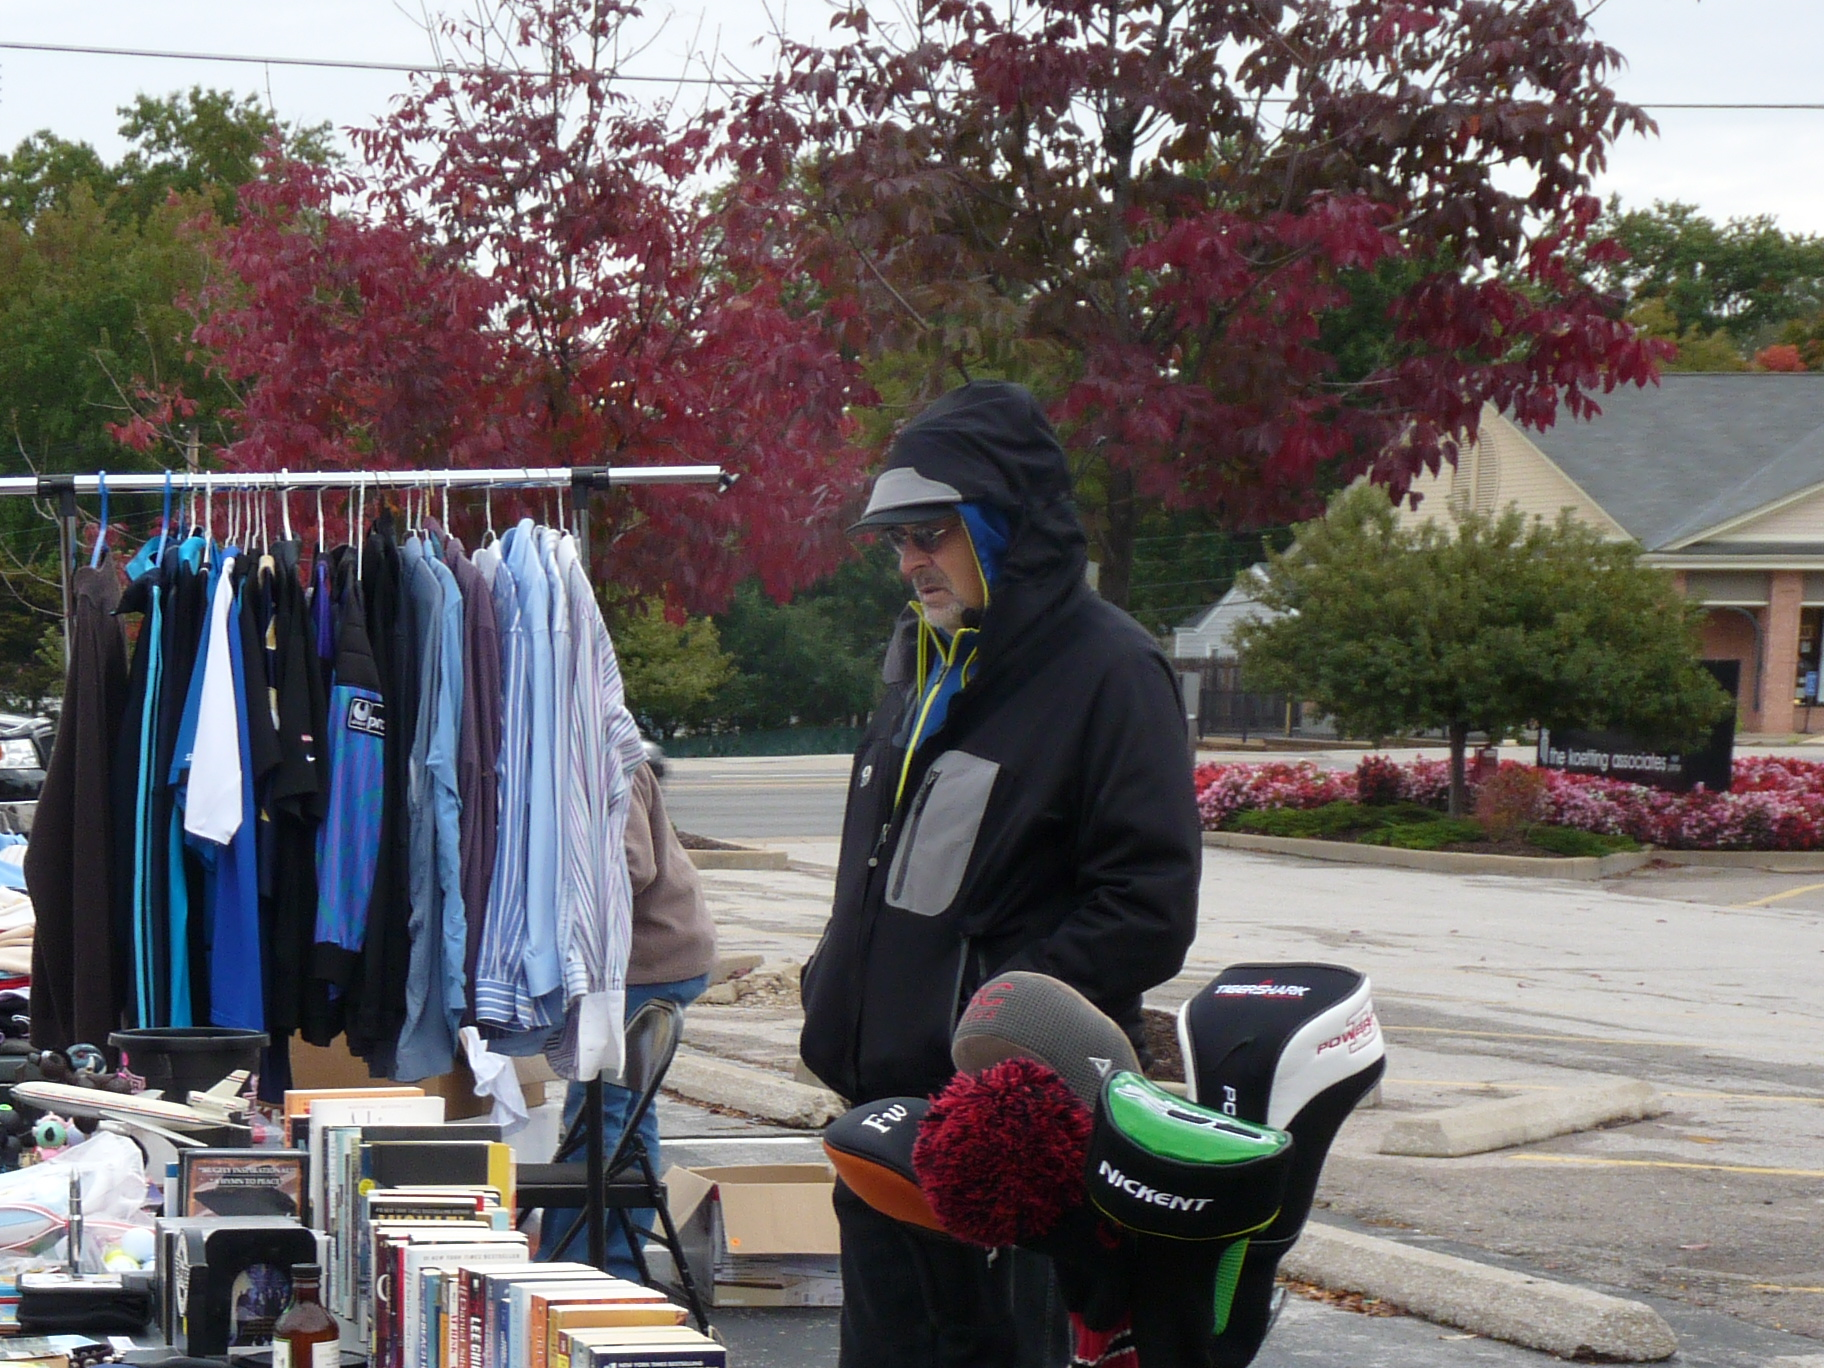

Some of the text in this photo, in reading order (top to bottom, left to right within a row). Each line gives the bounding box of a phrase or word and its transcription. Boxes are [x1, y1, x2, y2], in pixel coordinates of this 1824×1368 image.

[1612, 752, 1668, 772] associates
[1214, 984, 1311, 996] TIGERSHARK
[1098, 1160, 1214, 1213] NICKENT
[470, 1316, 482, 1342] LEE
